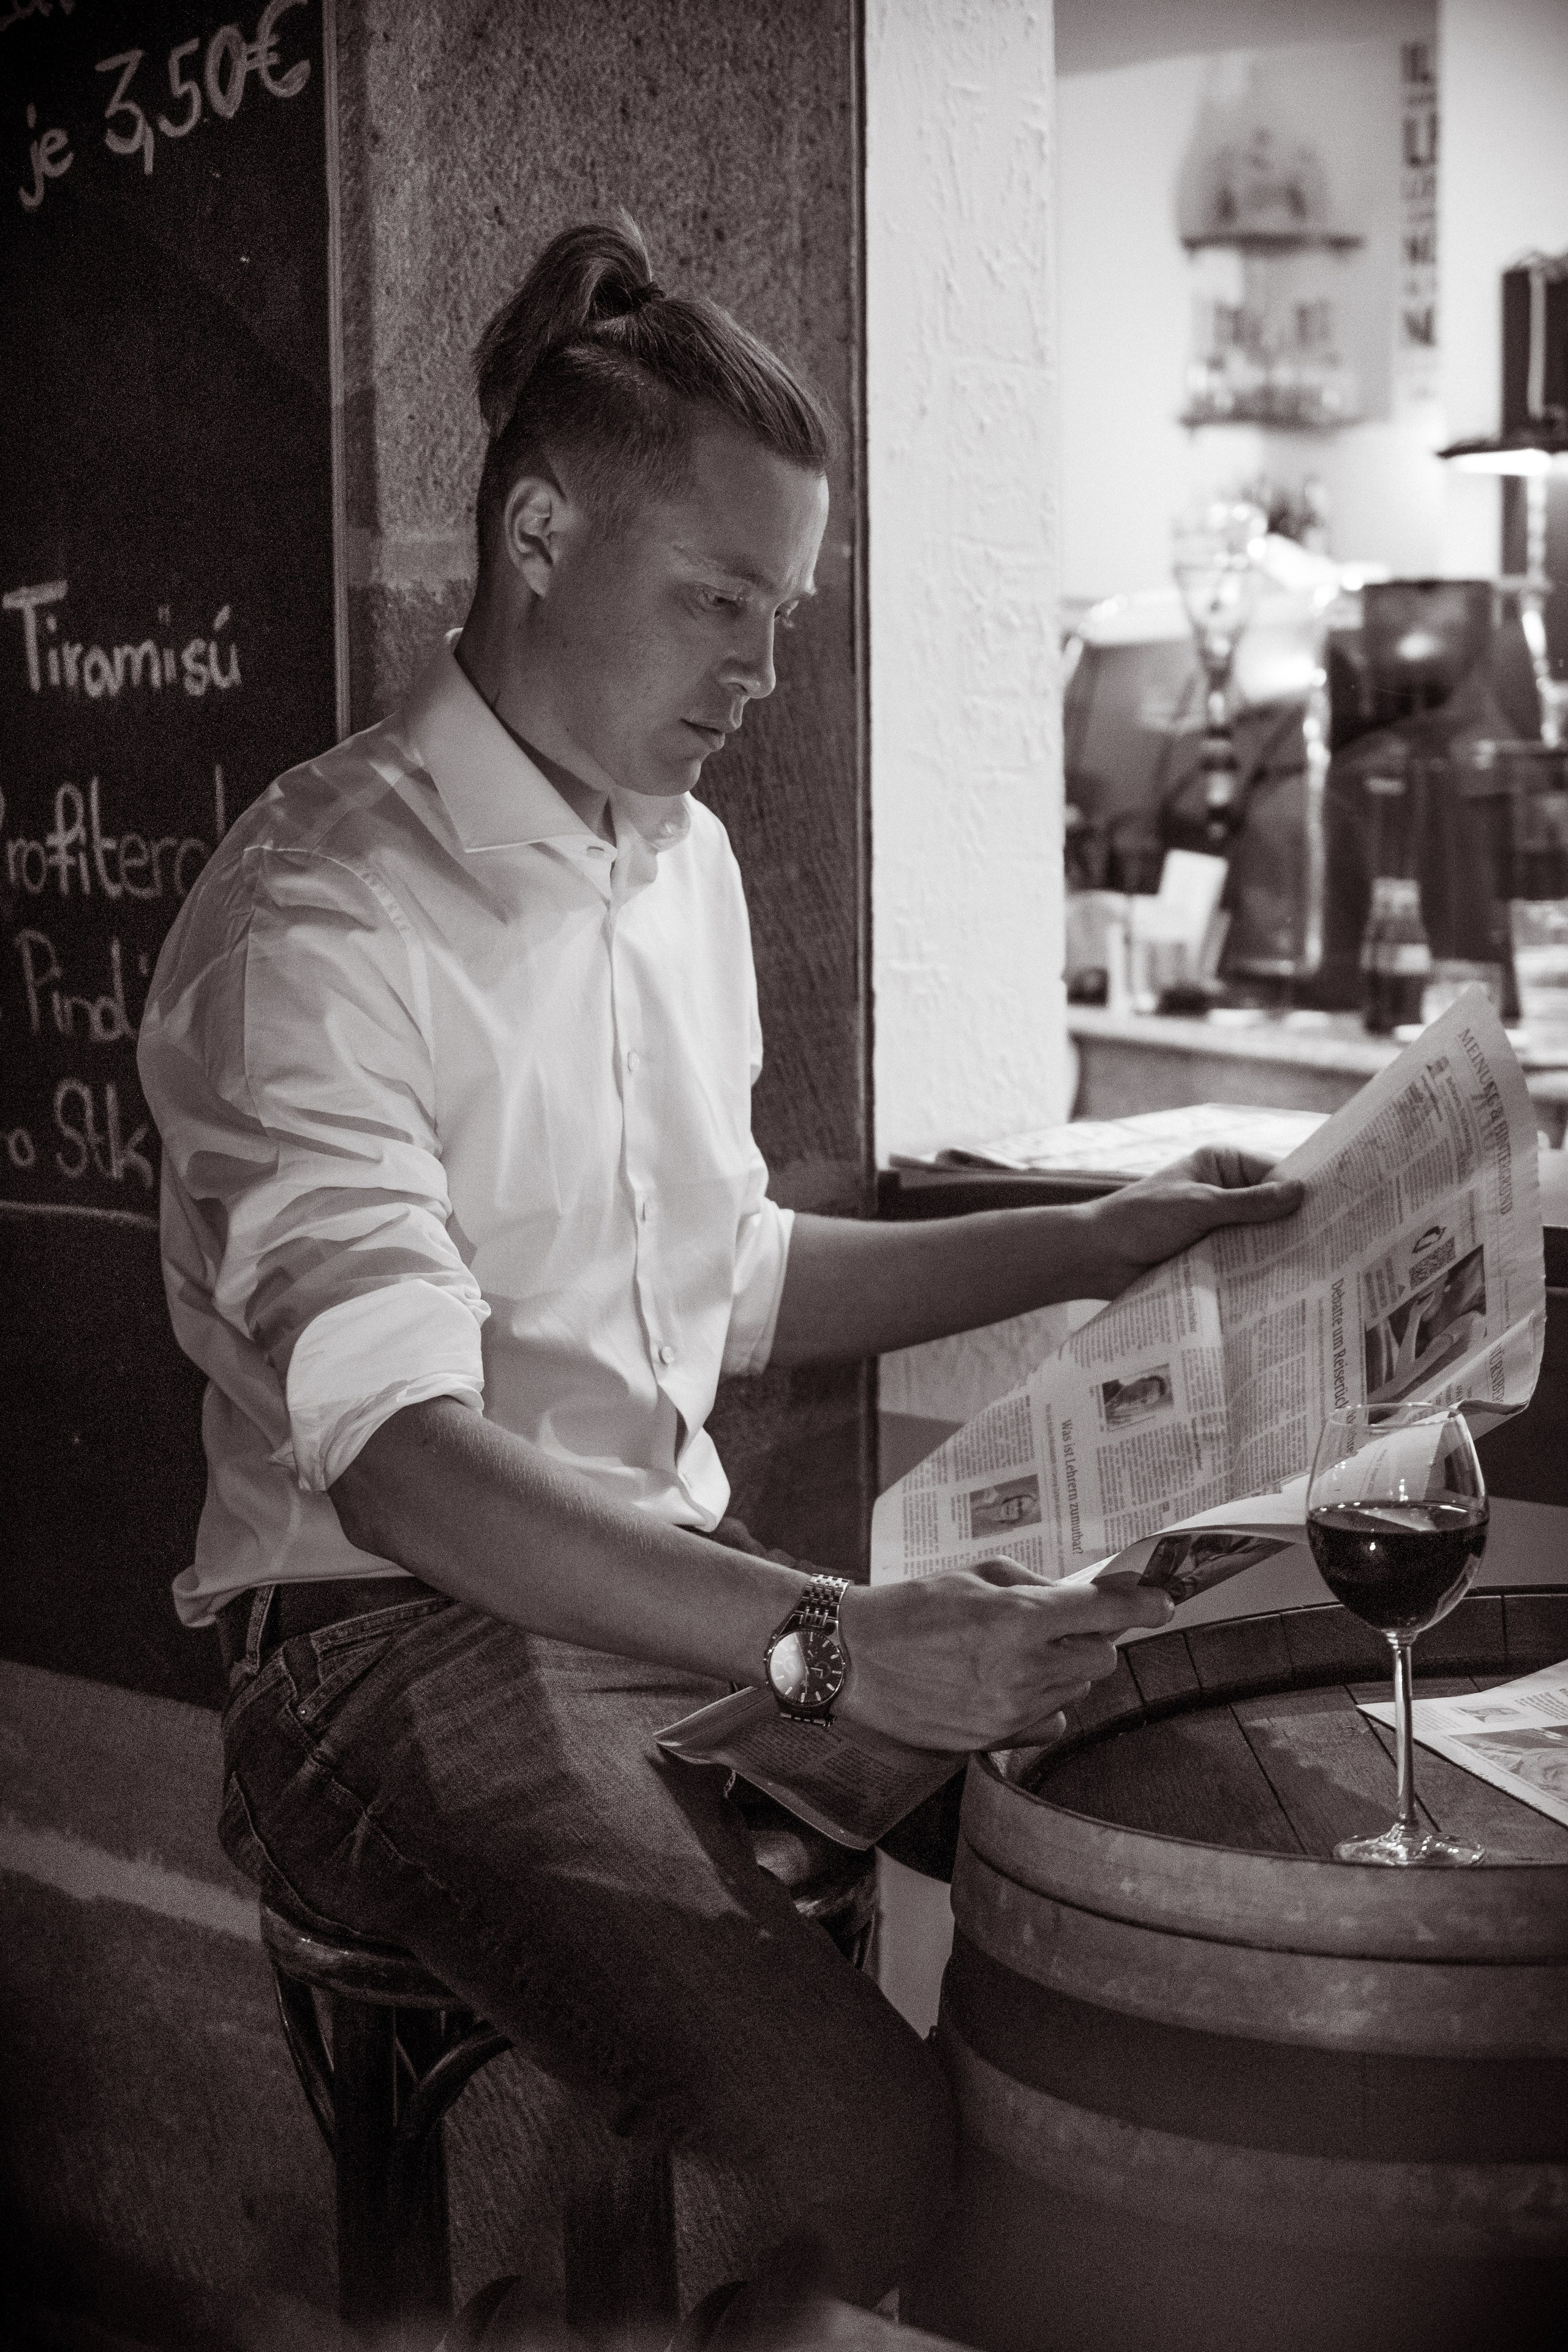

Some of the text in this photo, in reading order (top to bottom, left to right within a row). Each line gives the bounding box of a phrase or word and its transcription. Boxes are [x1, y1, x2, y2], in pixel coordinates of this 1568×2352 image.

[18, 103, 75, 213] je
[1332, 1277, 1344, 1327] Debatte
[1332, 1327, 1344, 1351] um
[1061, 1419, 1084, 1555] Was ist Lehrern zumutbar?
